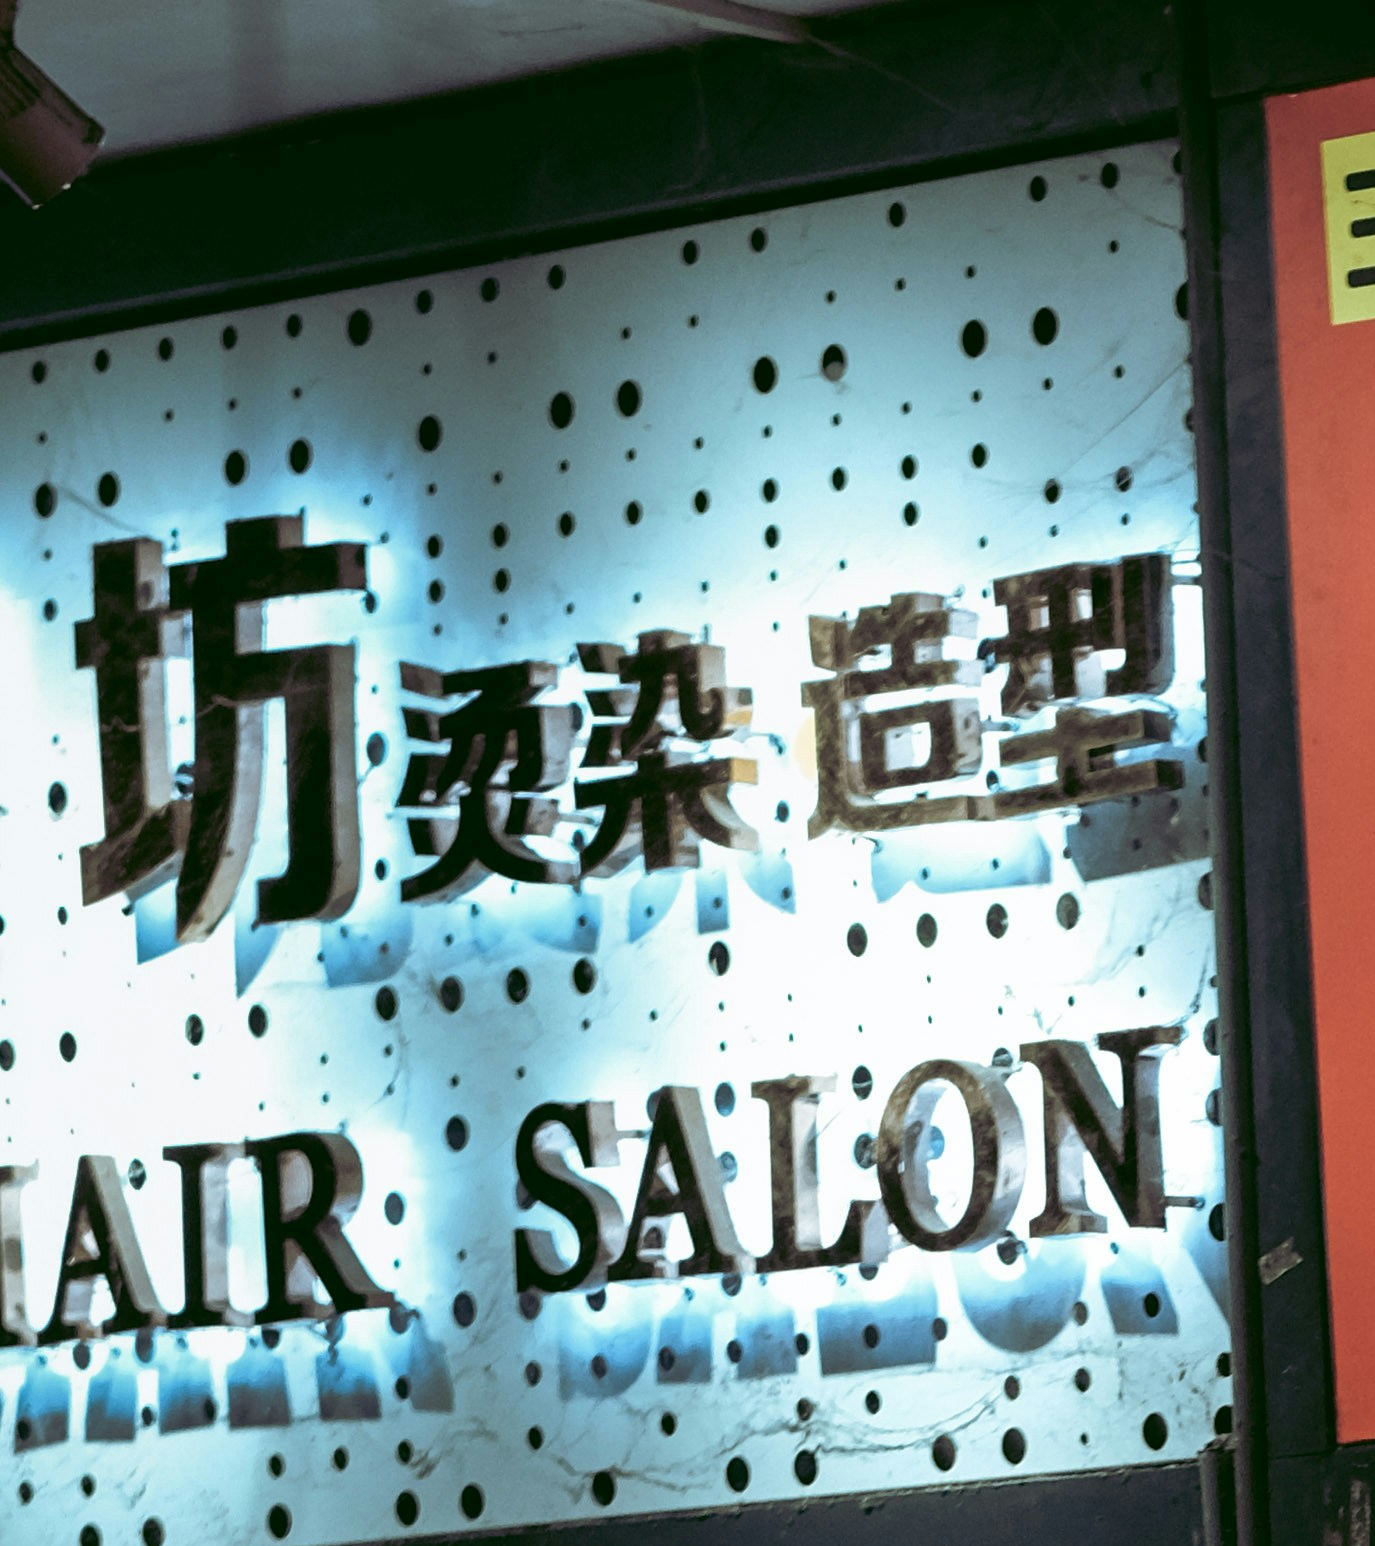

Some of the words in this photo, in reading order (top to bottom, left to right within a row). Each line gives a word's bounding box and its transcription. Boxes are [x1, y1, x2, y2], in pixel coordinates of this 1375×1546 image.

[73, 512, 367, 942] 坊
[400, 626, 760, 903] 烫染
[804, 551, 1184, 841] 造型
[514, 1025, 1184, 1296] SALON
